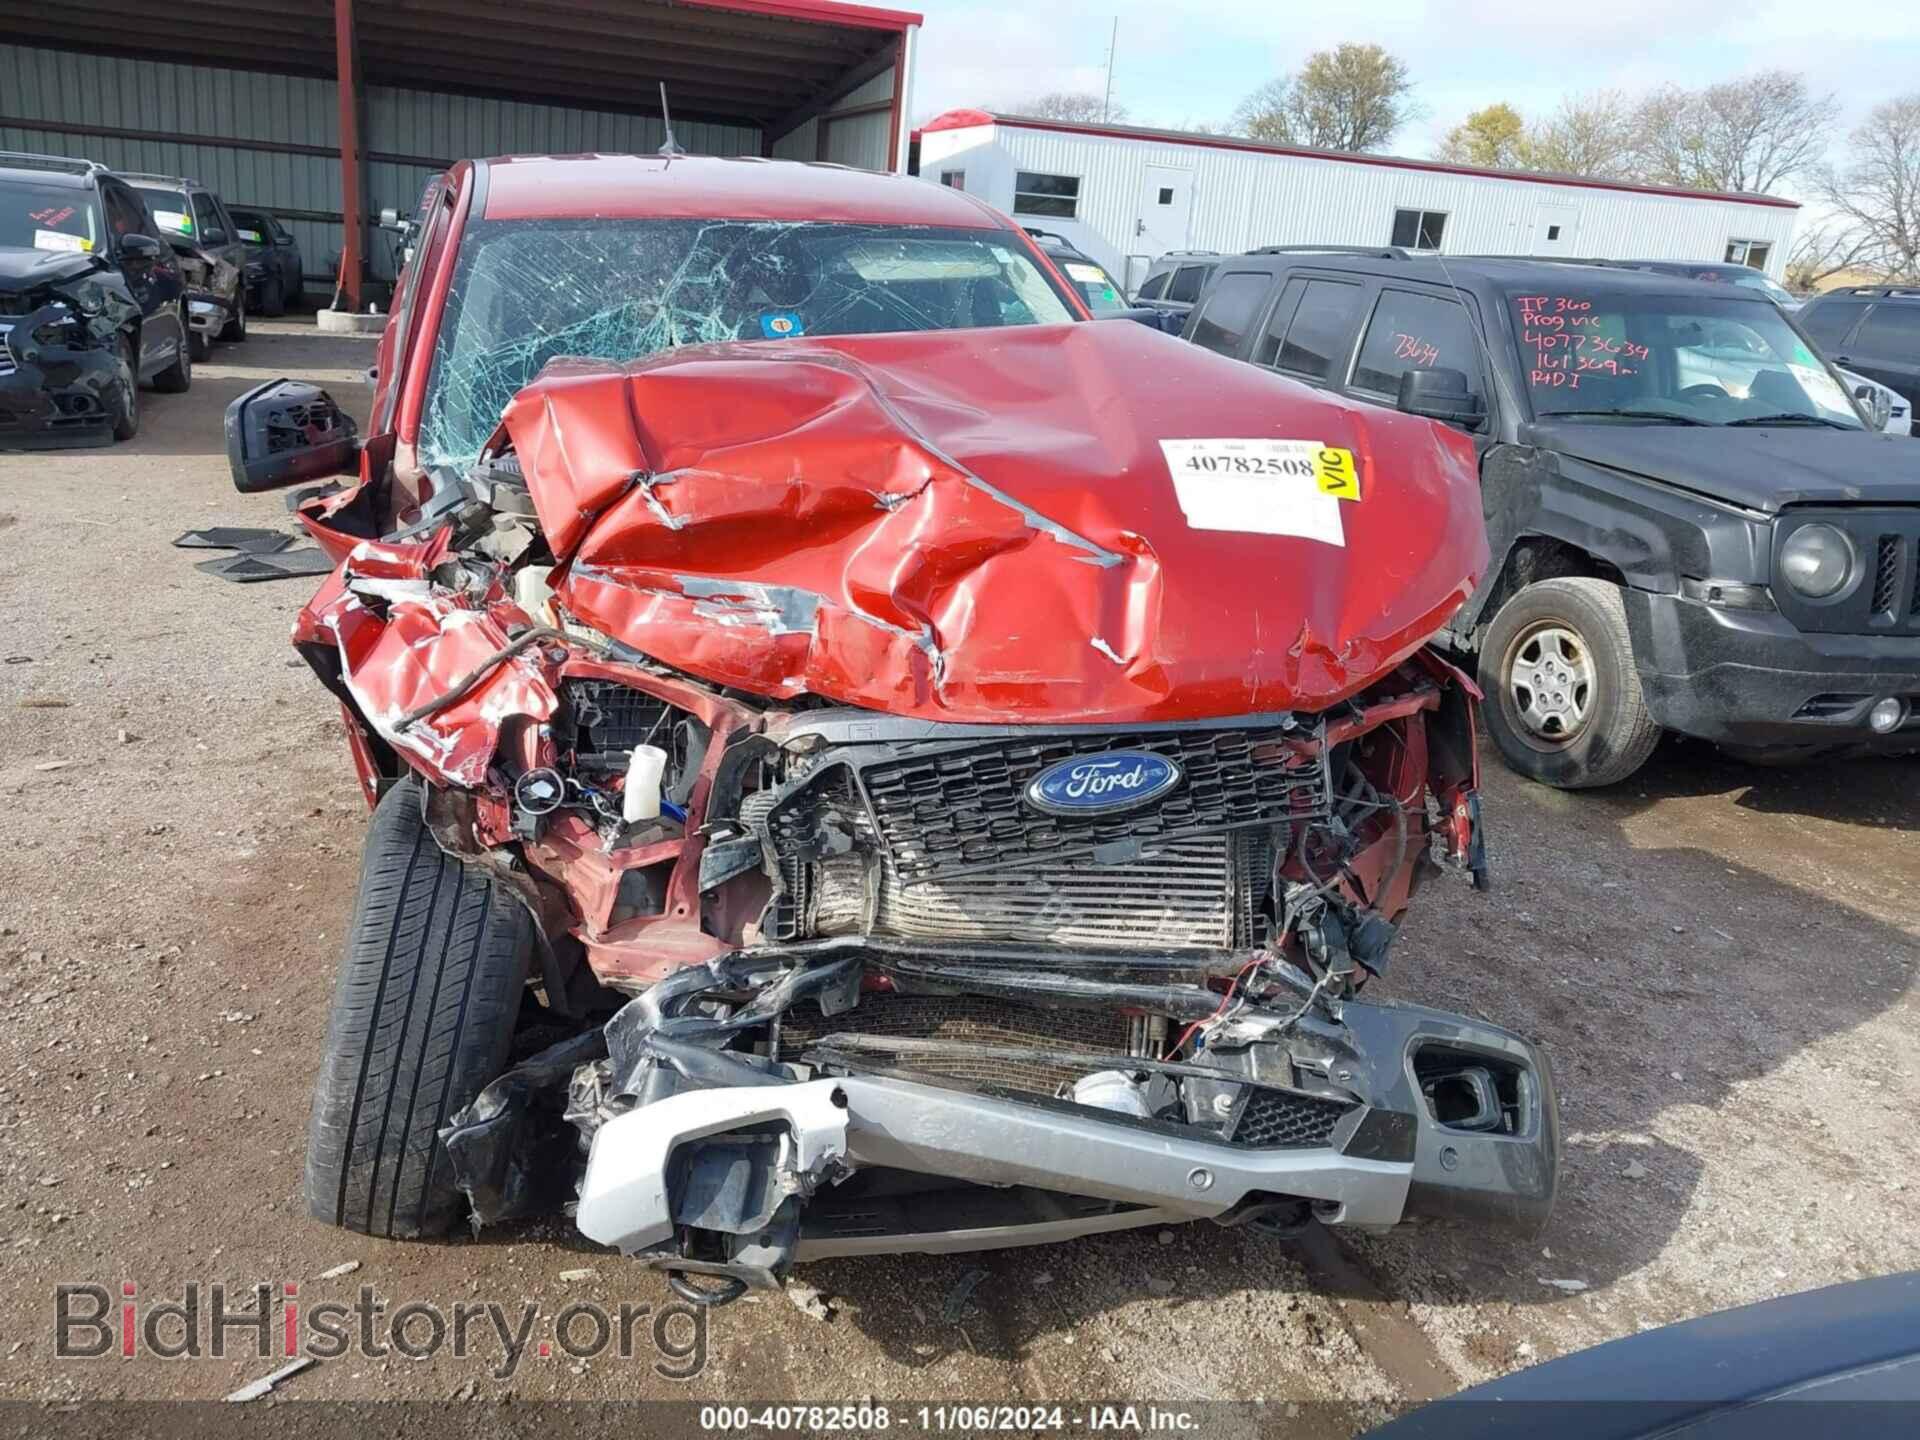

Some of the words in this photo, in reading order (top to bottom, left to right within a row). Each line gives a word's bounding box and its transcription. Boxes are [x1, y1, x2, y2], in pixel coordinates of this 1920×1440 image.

[1555, 298, 1591, 312] 360
[1186, 456, 1315, 477] 40782508
[1318, 451, 1347, 490] VIC
[1066, 761, 1143, 797] Ford
